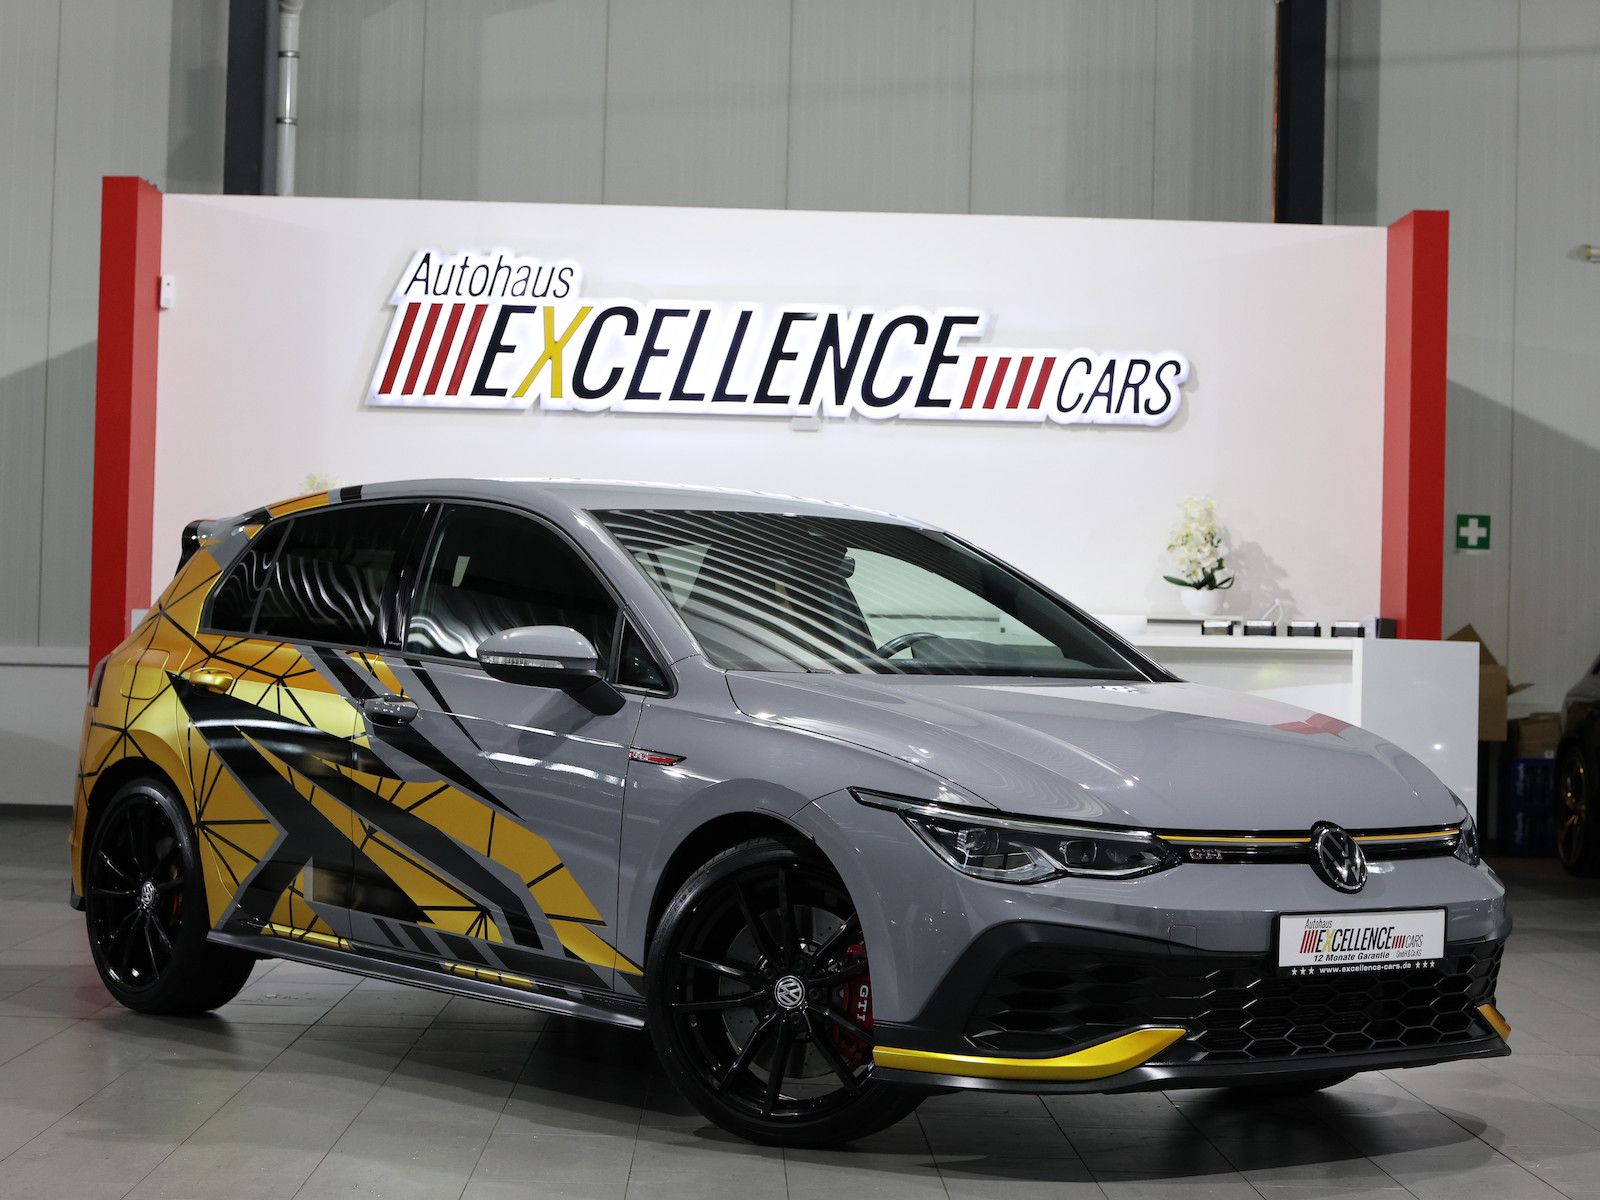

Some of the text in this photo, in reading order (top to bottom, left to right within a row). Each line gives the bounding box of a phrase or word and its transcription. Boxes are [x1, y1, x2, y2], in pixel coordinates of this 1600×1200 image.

[404, 252, 574, 298] Autohaus
[470, 304, 1182, 416] EXCELLENCE CARS
[1189, 848, 1223, 860] GTI
[1304, 918, 1333, 929] Autohaus
[1315, 926, 1424, 953] EXCELLENCE CARS
[1313, 951, 1390, 962] 12 Monate Garantie
[1319, 962, 1412, 974] www.excellence-cars.de
[857, 985, 869, 1021] GTI
